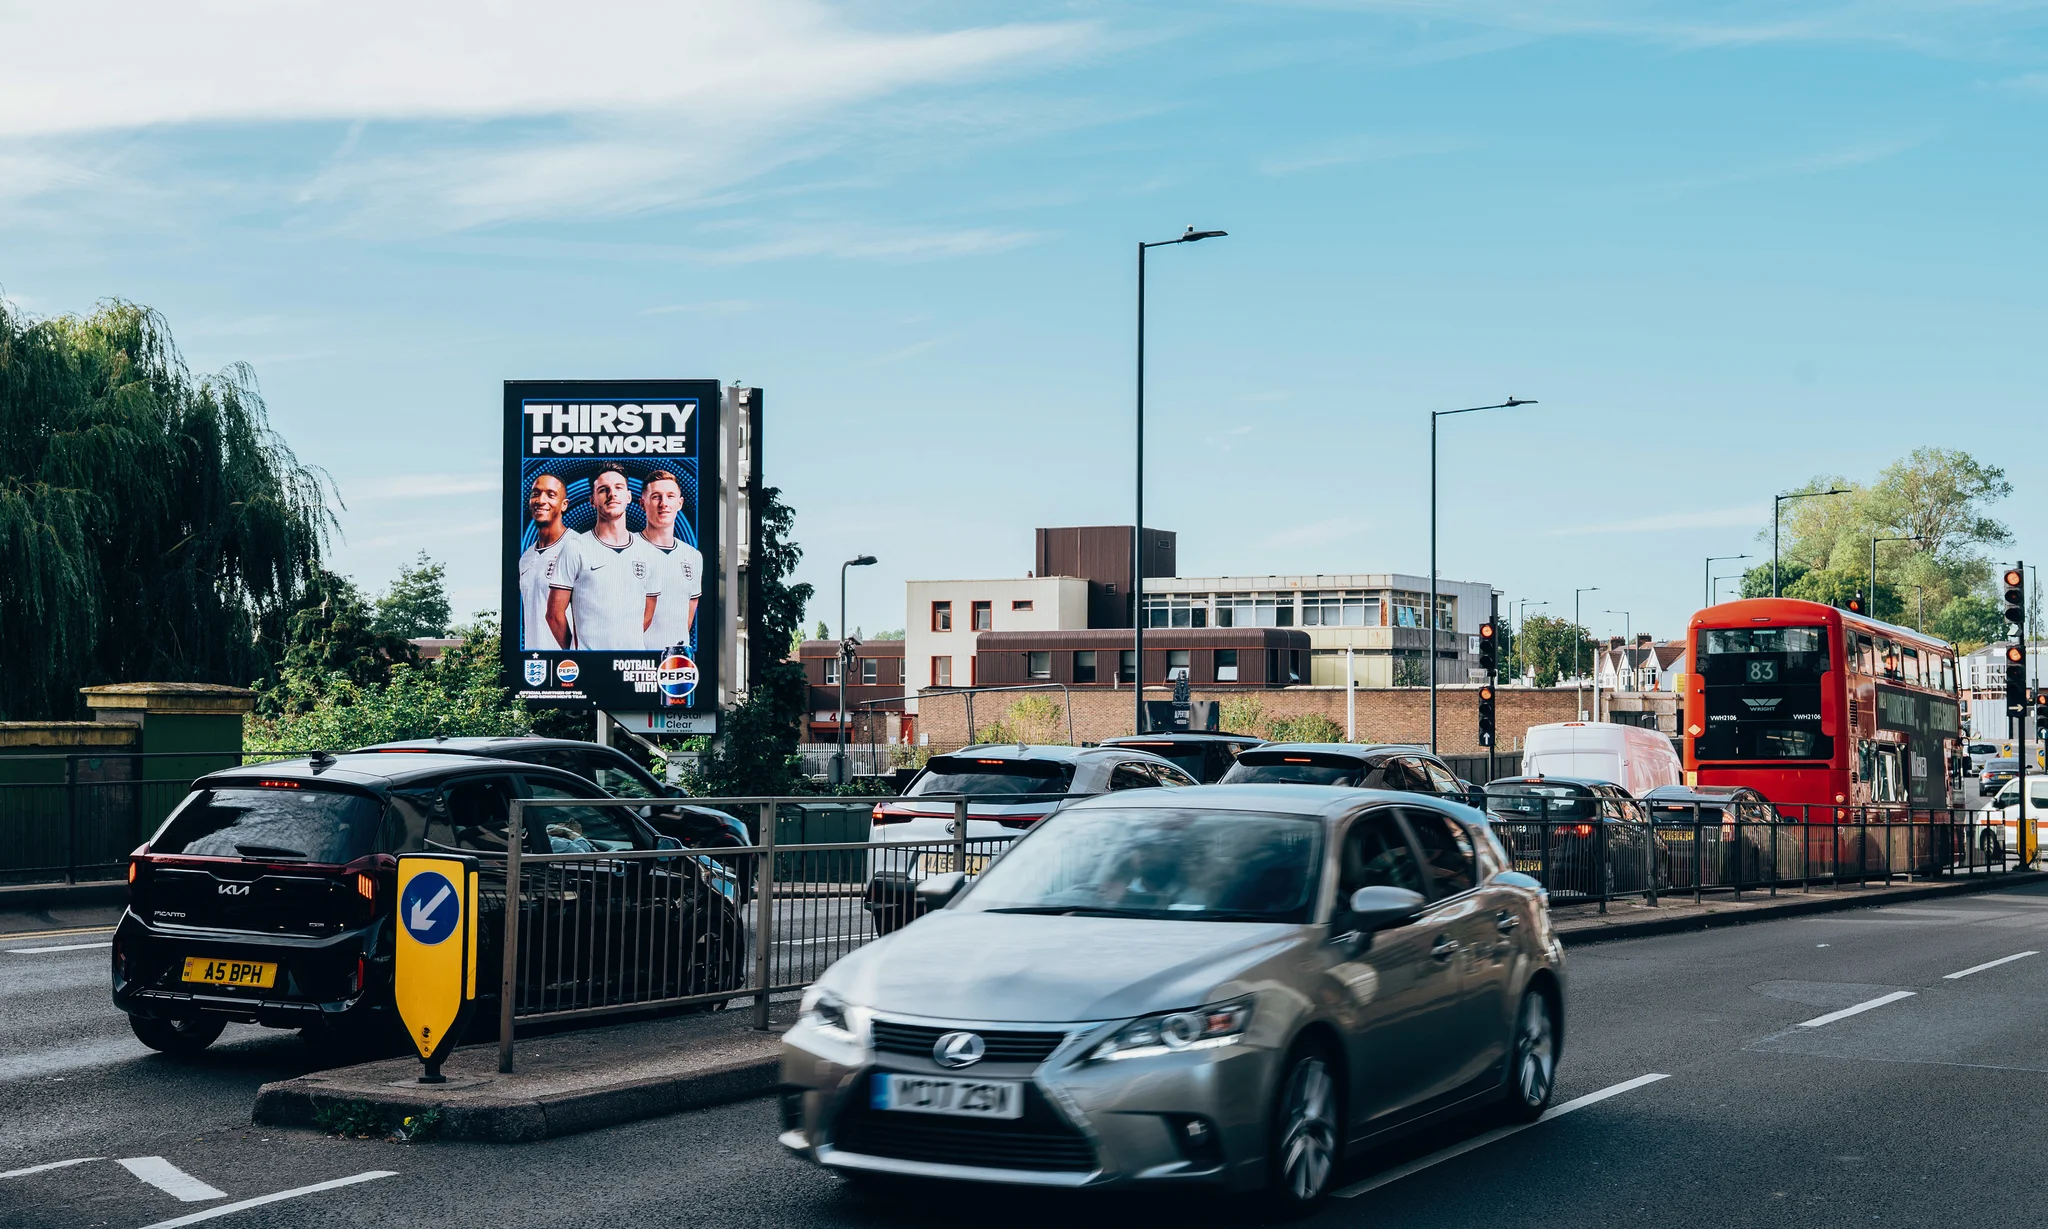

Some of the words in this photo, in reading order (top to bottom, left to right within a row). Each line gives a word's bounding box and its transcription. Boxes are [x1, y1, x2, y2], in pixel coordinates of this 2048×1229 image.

[524, 404, 696, 434] THIRSTY
[532, 436, 594, 454] FOR
[598, 435, 686, 454] MORE
[613, 659, 657, 671] FOOTBALL
[1750, 661, 1774, 680] 83
[623, 670, 657, 682] BETTER
[660, 672, 695, 680] PEPSI
[634, 681, 658, 693] WITH
[666, 711, 702, 721] Crystal
[829, 712, 838, 722] 4
[666, 720, 693, 729] Clear
[218, 884, 250, 896] KIA
[153, 910, 186, 918] PICANTO
[203, 961, 227, 981] A5
[228, 963, 264, 984] BPH
